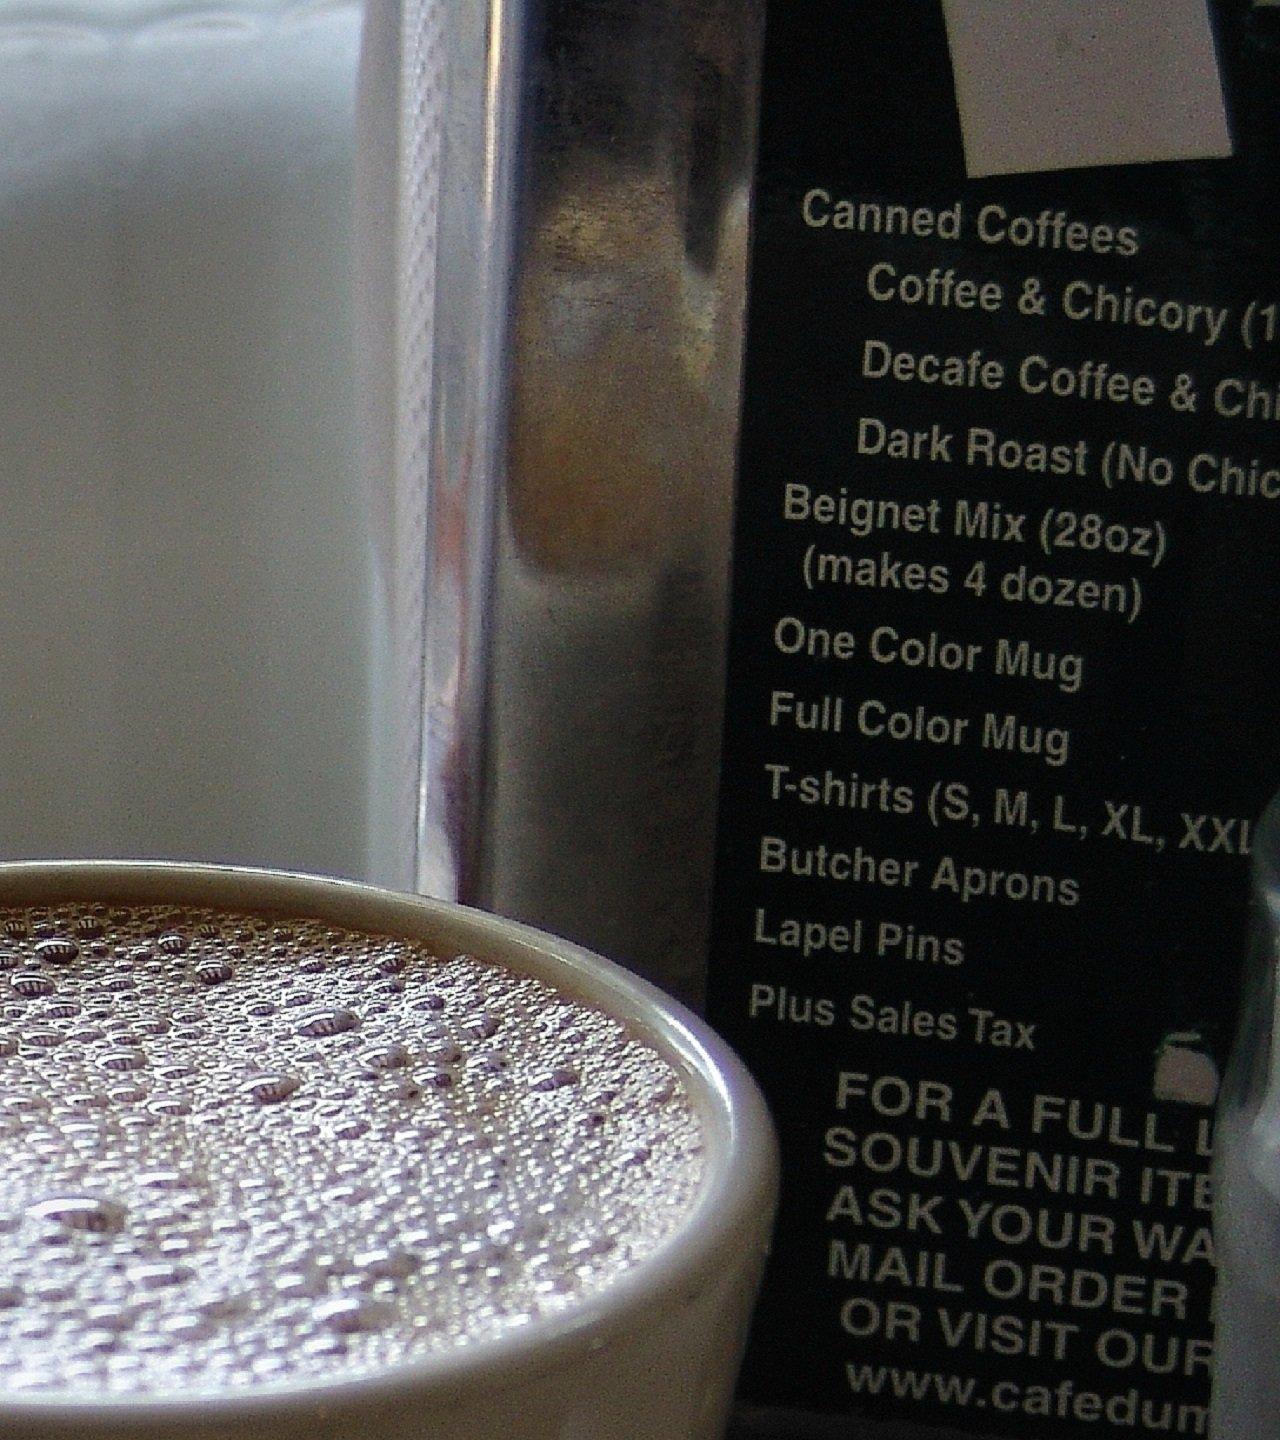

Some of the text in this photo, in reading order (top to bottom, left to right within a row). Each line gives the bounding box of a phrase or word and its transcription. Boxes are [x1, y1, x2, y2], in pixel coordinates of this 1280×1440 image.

[803, 188, 1138, 255] Canned Coffees
[868, 263, 1002, 311] Coffee
[1018, 278, 1045, 314] &
[1064, 281, 1227, 345] Chicory
[863, 340, 1004, 389] Decafe
[1020, 355, 1155, 405] Coffee
[1170, 373, 1196, 411] &
[858, 418, 952, 461] Dark
[968, 428, 1087, 475] Roast
[1102, 443, 1173, 486] (No
[785, 483, 1165, 566] Beignet Mix (28oz)
[804, 545, 1141, 621] (makes 4 dozen)
[775, 617, 1082, 692] One Color Mug
[771, 691, 1068, 765] Full Color Mug
[766, 764, 913, 813] T-shirts
[928, 781, 982, 829] (S,
[994, 789, 1038, 834] M,
[1053, 796, 1088, 840] L,
[1101, 800, 1166, 853] XL,
[761, 837, 1077, 904] Butcher Aprons
[756, 909, 962, 964] Lapel Pins
[751, 985, 1033, 1047] Plus Sales Tax
[838, 1073, 952, 1120] FOR
[974, 1091, 1008, 1127] A
[1034, 1096, 1173, 1151] FULL
[824, 1128, 1121, 1199] SOUVENIR
[828, 1187, 1216, 1268] ASK YOUR WA
[830, 1242, 961, 1291] MAIL
[985, 1261, 1186, 1317] ORDER
[843, 1300, 919, 1339] OR
[939, 1309, 1079, 1362] VISIT
